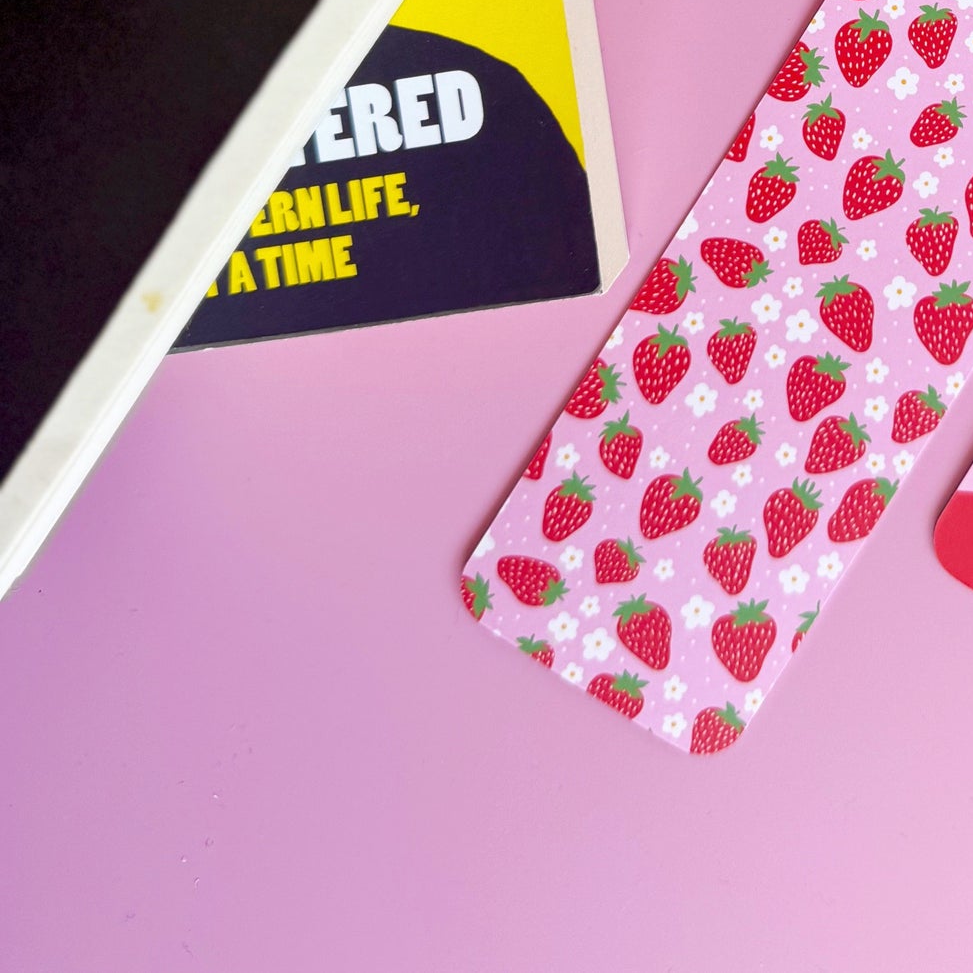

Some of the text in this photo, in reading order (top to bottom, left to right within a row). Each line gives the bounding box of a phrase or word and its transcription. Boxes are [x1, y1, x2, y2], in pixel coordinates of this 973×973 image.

[289, 69, 485, 168] ERED
[325, 172, 421, 226] LIFE,
[227, 234, 358, 296] A TIME
